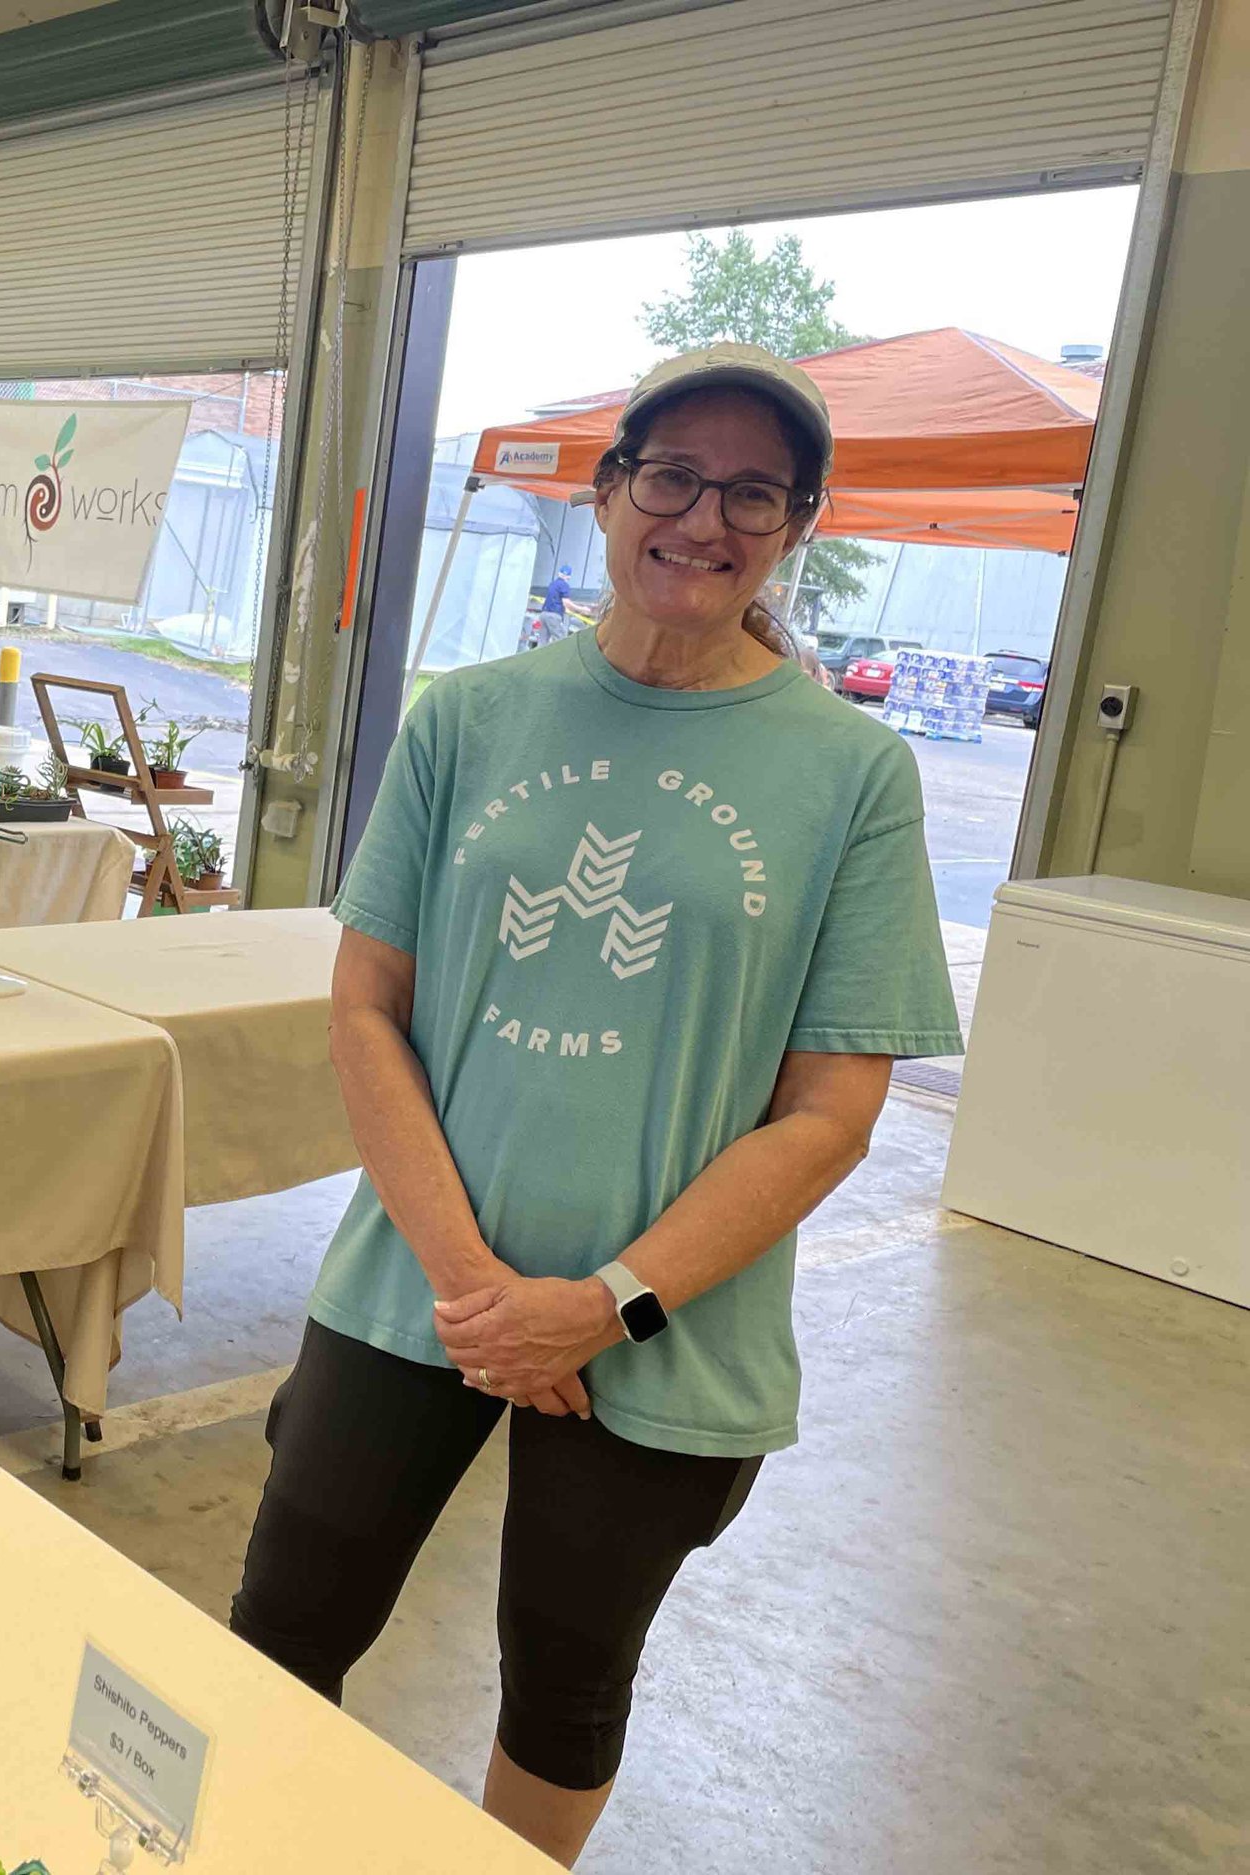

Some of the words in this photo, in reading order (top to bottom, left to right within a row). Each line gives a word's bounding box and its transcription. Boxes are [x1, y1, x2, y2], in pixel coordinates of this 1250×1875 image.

[513, 451, 553, 461] Academy
[454, 760, 610, 865] FERTILE
[657, 770, 766, 917] GROUND
[482, 1003, 623, 1056] FARMS
[93, 1674, 137, 1720] Shishito
[138, 1710, 188, 1761] Peppers
[109, 1731, 125, 1755] $3
[133, 1750, 156, 1781] Box
